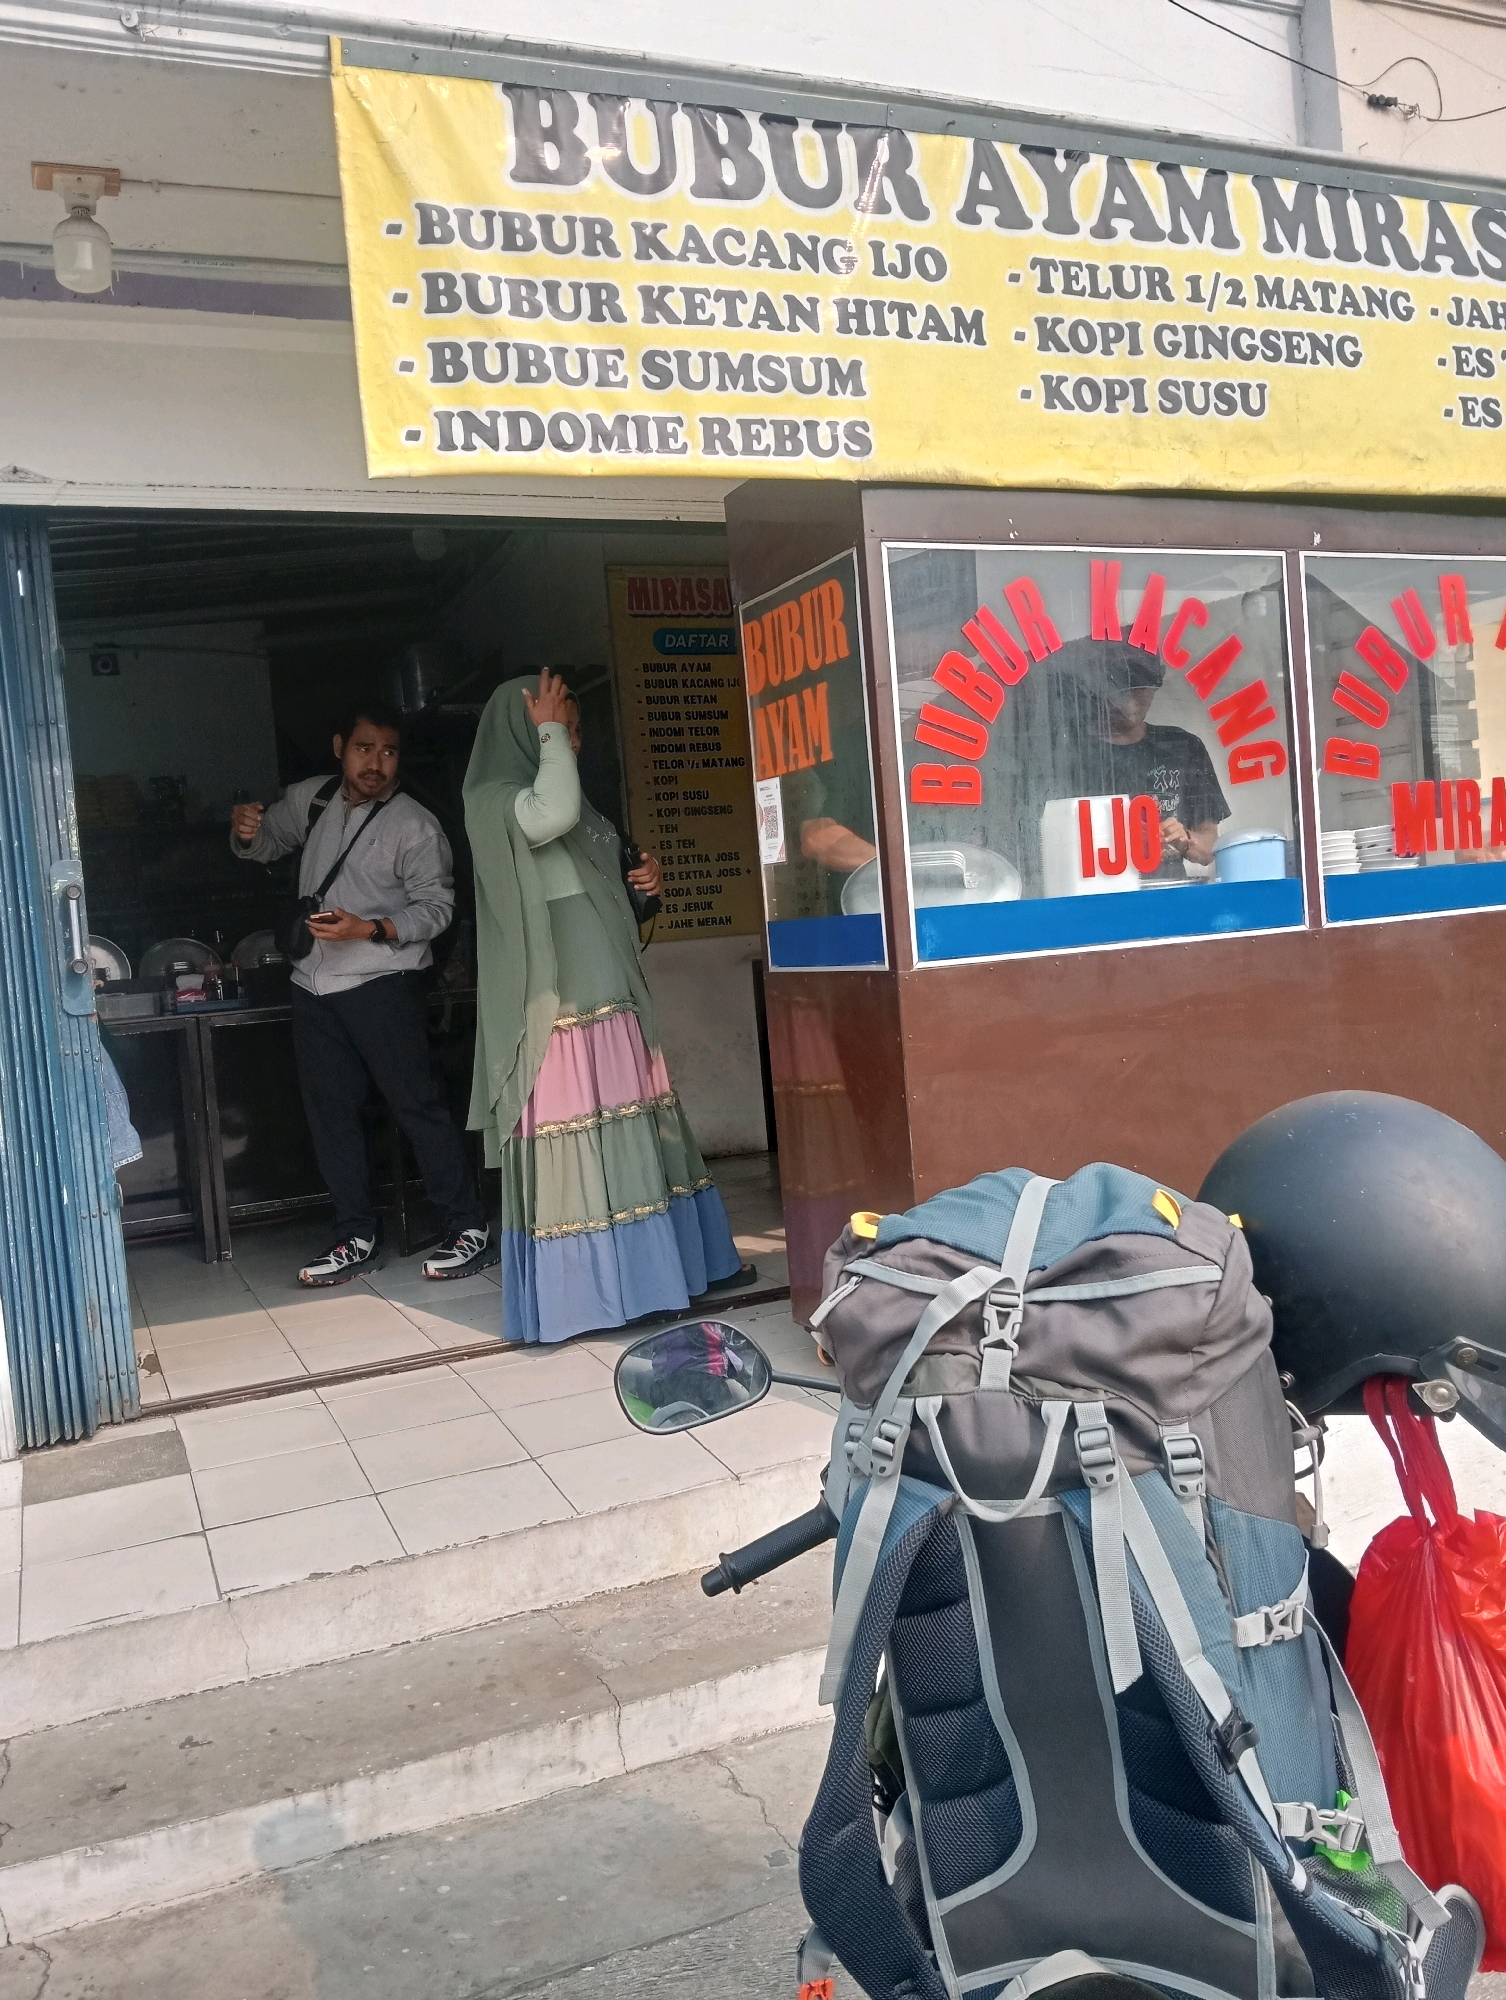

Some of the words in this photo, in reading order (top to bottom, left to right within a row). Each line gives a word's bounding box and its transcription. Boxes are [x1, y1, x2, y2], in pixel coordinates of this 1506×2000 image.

[502, 83, 930, 221] BUBUR
[956, 138, 1240, 250] AYAM
[1252, 175, 1506, 282] MIRAS
[415, 202, 621, 259] BUBUR
[631, 221, 858, 275] KACANG
[869, 240, 948, 283] IJO
[1030, 257, 1174, 300] TELUR
[1185, 271, 1246, 312] 1/2
[1256, 275, 1415, 322] MATANG
[421, 272, 628, 324] BUBUR
[637, 285, 821, 334] KETAN
[834, 298, 987, 346] HITAM
[1447, 297, 1506, 330] JAH
[1034, 317, 1144, 358] KOPI
[1153, 324, 1363, 368] GINGSENG
[427, 341, 629, 390] BUBUE
[642, 350, 868, 397] SUMSUM
[1452, 346, 1495, 378] ES
[1040, 374, 1148, 414] KOPI
[1158, 382, 1268, 417] SUSU
[1458, 396, 1502, 428] ES
[433, 411, 688, 456] INDOMIE
[698, 417, 872, 458] REBUS
[627, 577, 730, 611] MIRASA
[664, 633, 729, 648] DAFTAR
[743, 578, 850, 696] BUBUR
[642, 662, 677, 673] BUBUR
[681, 662, 712, 673] AYAM
[1324, 573, 1474, 780] BUBUR
[644, 678, 679, 689] BUBUR
[681, 677, 725, 689] KACANG
[910, 576, 1063, 805] BUBUR
[1090, 559, 1288, 785] KACANG
[645, 695, 680, 706] BUBUR
[683, 695, 718, 705] KETAN
[647, 711, 682, 722] BUBUR
[685, 710, 729, 721] SUMSUM
[649, 727, 684, 738] INDOMI
[688, 726, 720, 737] TELOR
[753, 682, 833, 781] AYAM
[651, 743, 686, 754] INDOMI
[689, 742, 722, 753] REBUS
[652, 759, 684, 770] TELOR
[702, 757, 745, 768] MATANG
[653, 775, 678, 786] KOPI
[655, 791, 679, 802] KOPI
[683, 790, 709, 801] SUSU
[656, 807, 681, 818] KOPI
[684, 805, 733, 816] GINGSENG
[1391, 777, 1506, 855] MIRA
[658, 823, 679, 834] TEH
[1078, 795, 1162, 876] IJO
[659, 840, 672, 850] ES
[676, 839, 696, 849] TEH
[661, 856, 675, 866] ES
[677, 853, 711, 865] EXTRA
[715, 852, 740, 862] JOSS
[663, 872, 676, 882] ES
[678, 869, 712, 880] EXTRA
[716, 867, 742, 878] JOSS
[664, 887, 692, 898] SODA
[696, 885, 722, 895] SUSU
[666, 903, 678, 914] ES
[682, 901, 714, 912] JERUK
[668, 917, 694, 929] JAHE
[697, 915, 732, 927] MERAH
